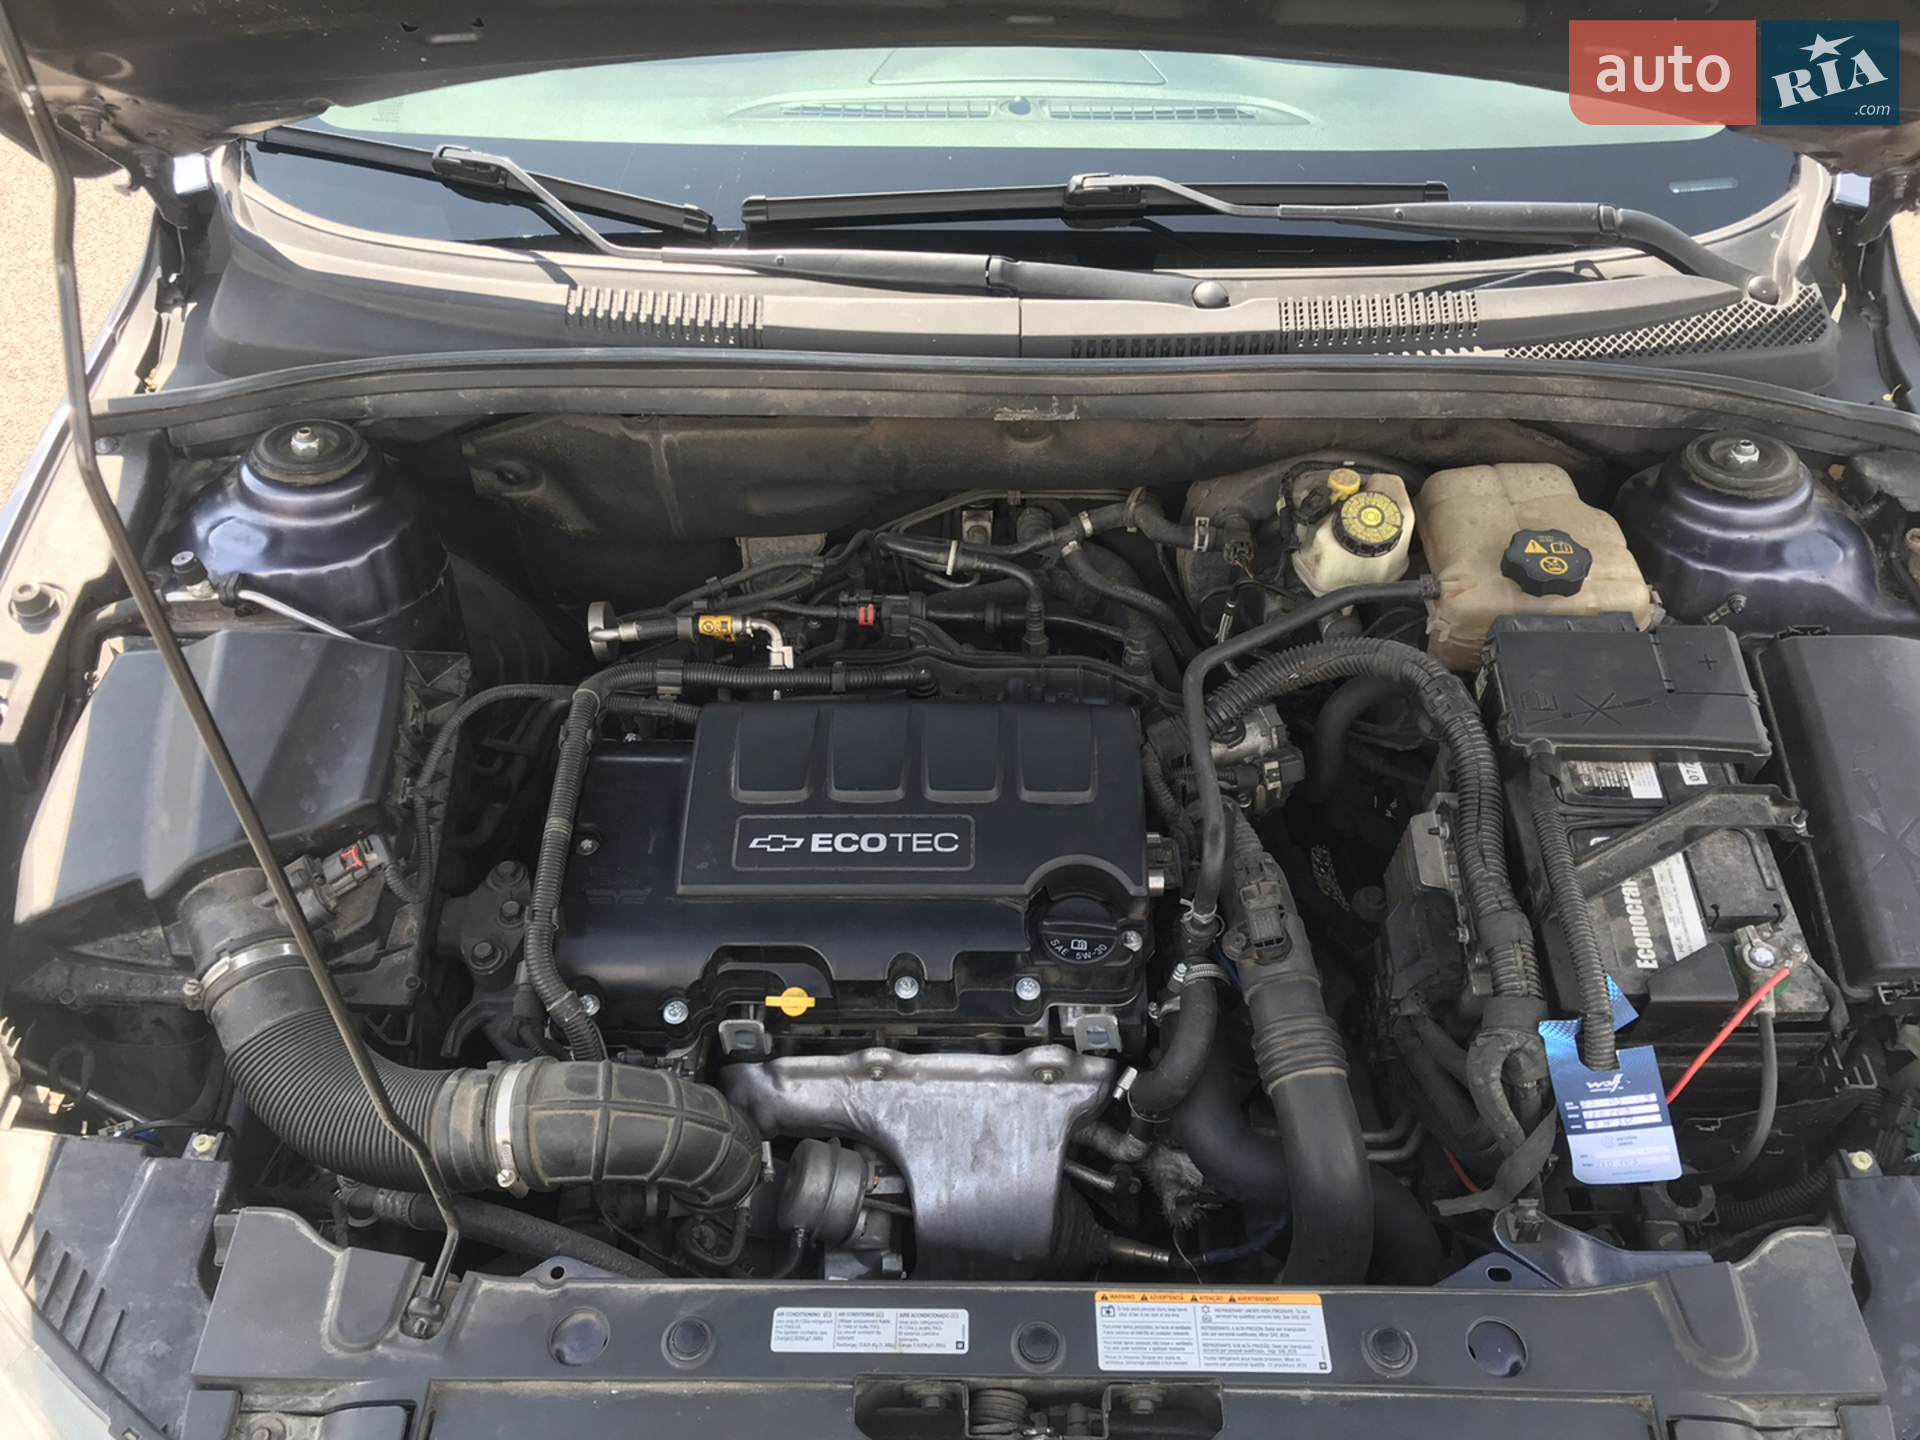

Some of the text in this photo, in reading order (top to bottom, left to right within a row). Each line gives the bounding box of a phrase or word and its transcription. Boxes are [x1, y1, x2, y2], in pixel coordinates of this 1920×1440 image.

[811, 833, 960, 853] ECOTEC
[1050, 938, 1108, 960] SAE 5W-30
